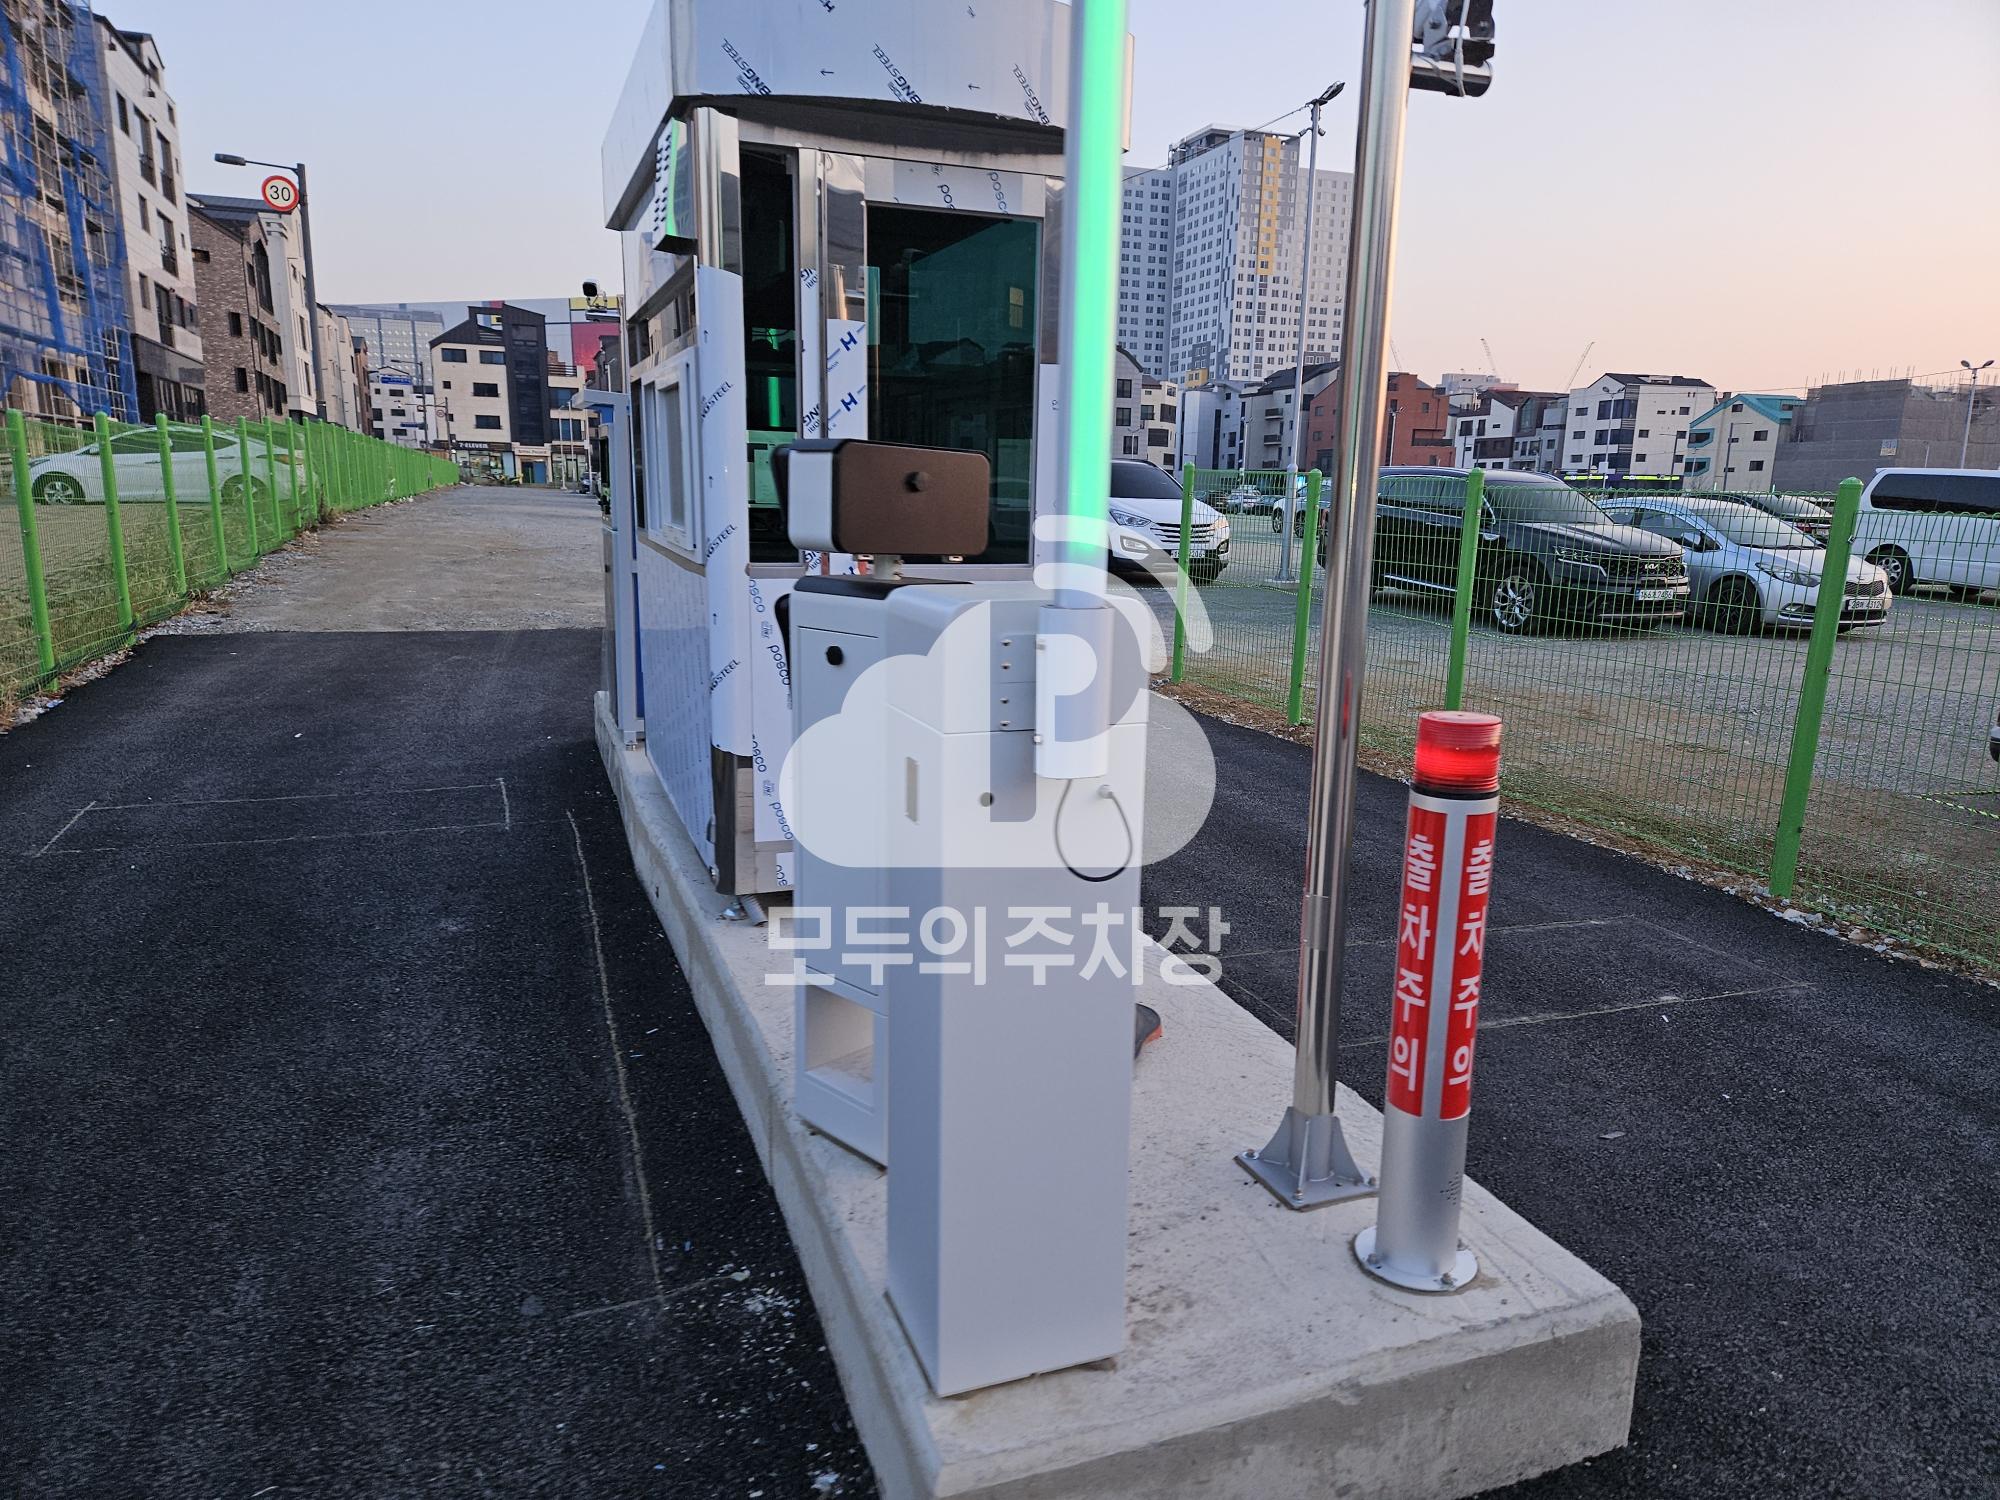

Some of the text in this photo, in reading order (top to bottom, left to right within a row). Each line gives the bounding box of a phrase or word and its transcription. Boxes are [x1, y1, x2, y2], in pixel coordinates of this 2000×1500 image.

[721, 38, 772, 95] BNGSTEEL
[872, 42, 922, 104] BNGSTEEL
[1012, 63, 1050, 125] BNGSTEEL
[270, 185, 290, 201] 30
[987, 171, 1008, 214] posc
[767, 644, 791, 686] posco
[1391, 833, 1437, 1092] 출차주의
